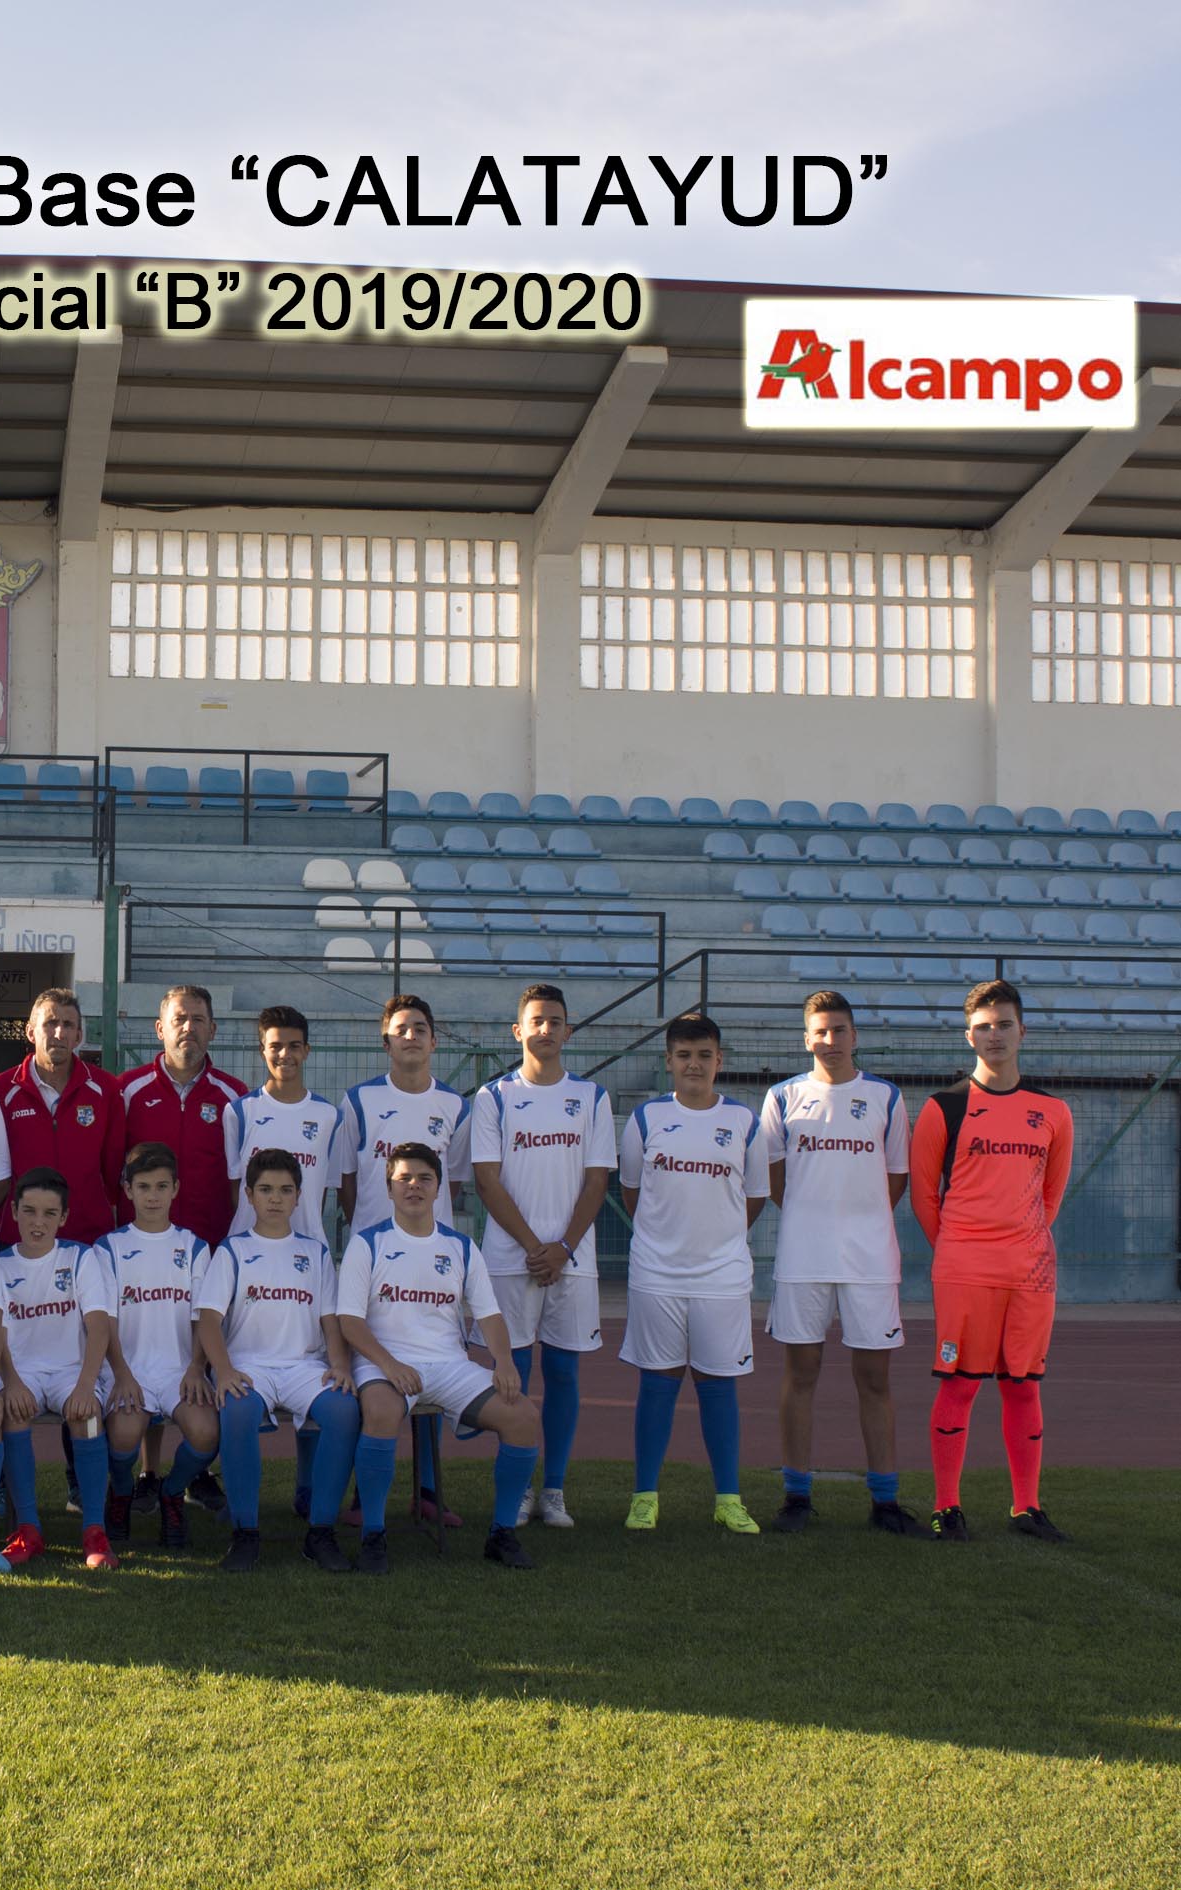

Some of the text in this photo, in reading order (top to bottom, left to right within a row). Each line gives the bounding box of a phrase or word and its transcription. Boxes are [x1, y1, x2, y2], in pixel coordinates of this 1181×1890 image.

[16, 929, 76, 952] IÑIGO
[513, 1130, 582, 1151] Alcampo
[795, 1133, 875, 1156] Alcampo
[968, 1136, 1047, 1160] Alcampo
[652, 1152, 732, 1179] Alcampo
[378, 1283, 455, 1308] Alcampo
